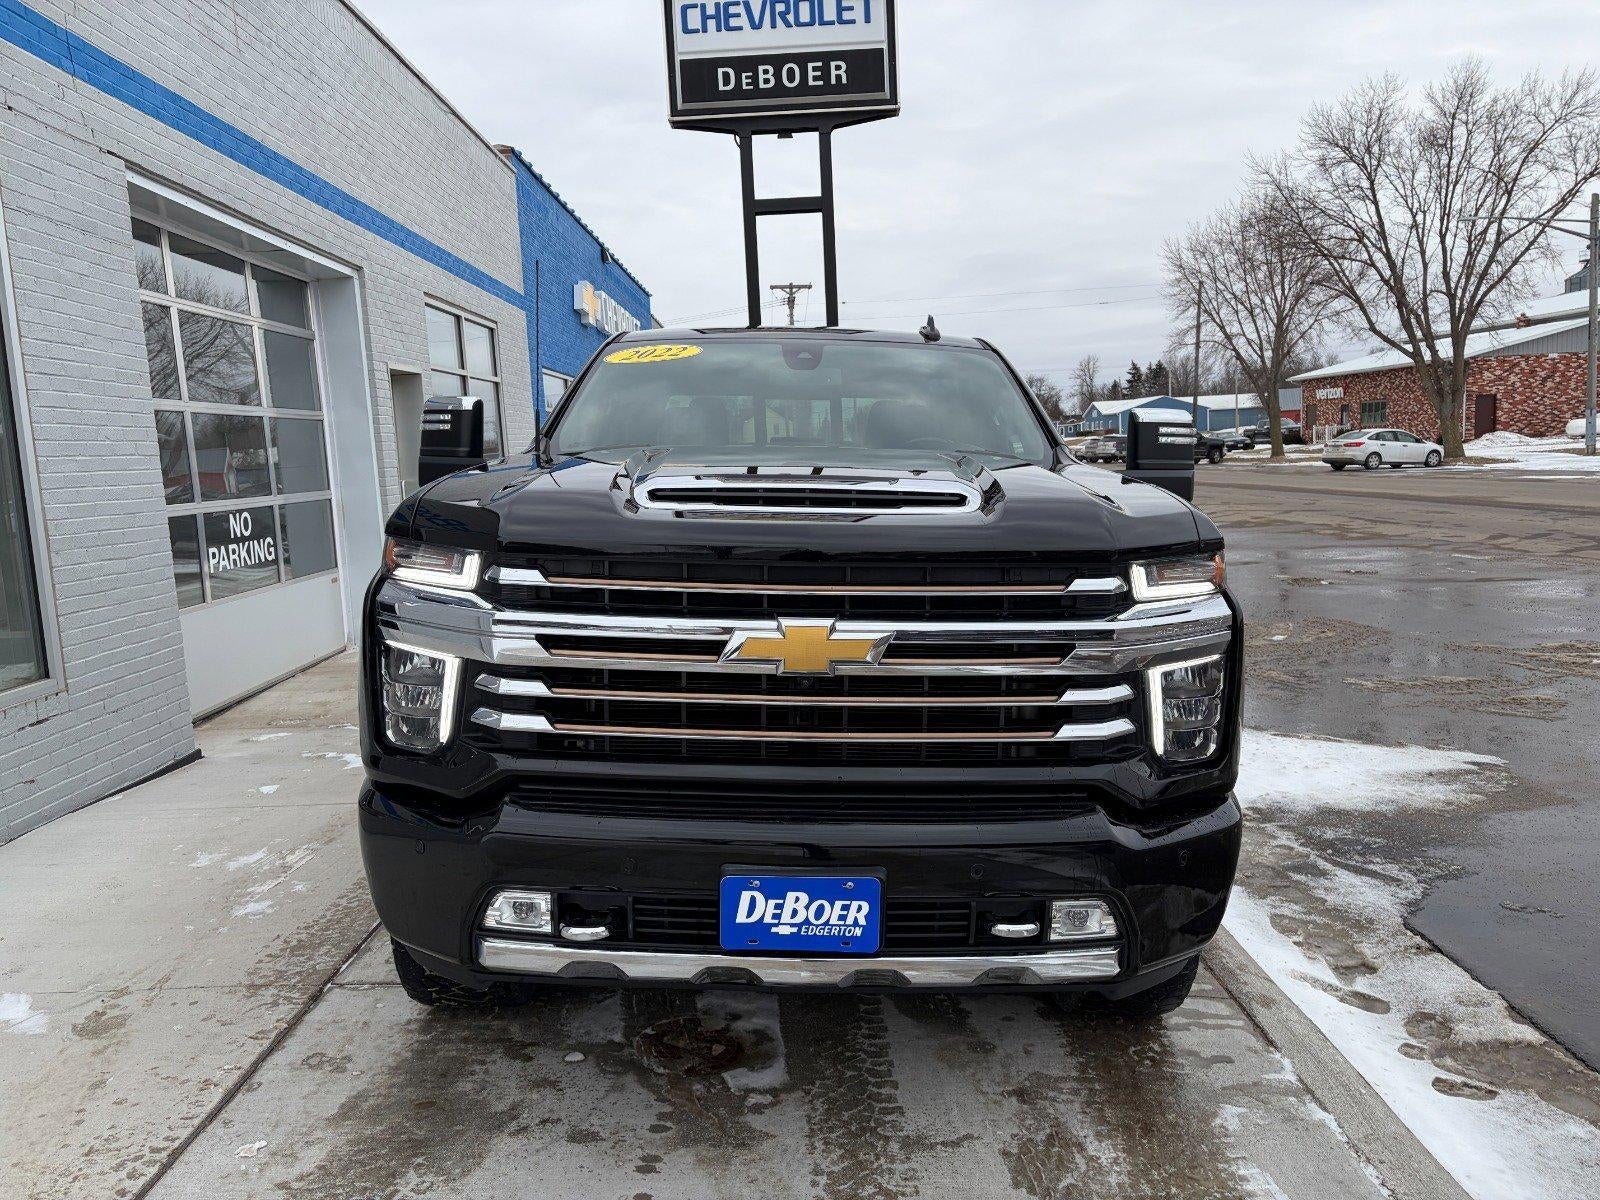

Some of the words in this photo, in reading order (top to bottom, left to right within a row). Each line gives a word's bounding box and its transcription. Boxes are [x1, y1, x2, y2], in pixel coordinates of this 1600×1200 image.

[680, 0, 873, 34] CHEVROLET
[618, 346, 688, 361] 2022
[1315, 387, 1344, 400] verizon
[229, 511, 252, 538] NO
[208, 536, 275, 573] PARKING
[800, 925, 863, 937] EDGERTON
